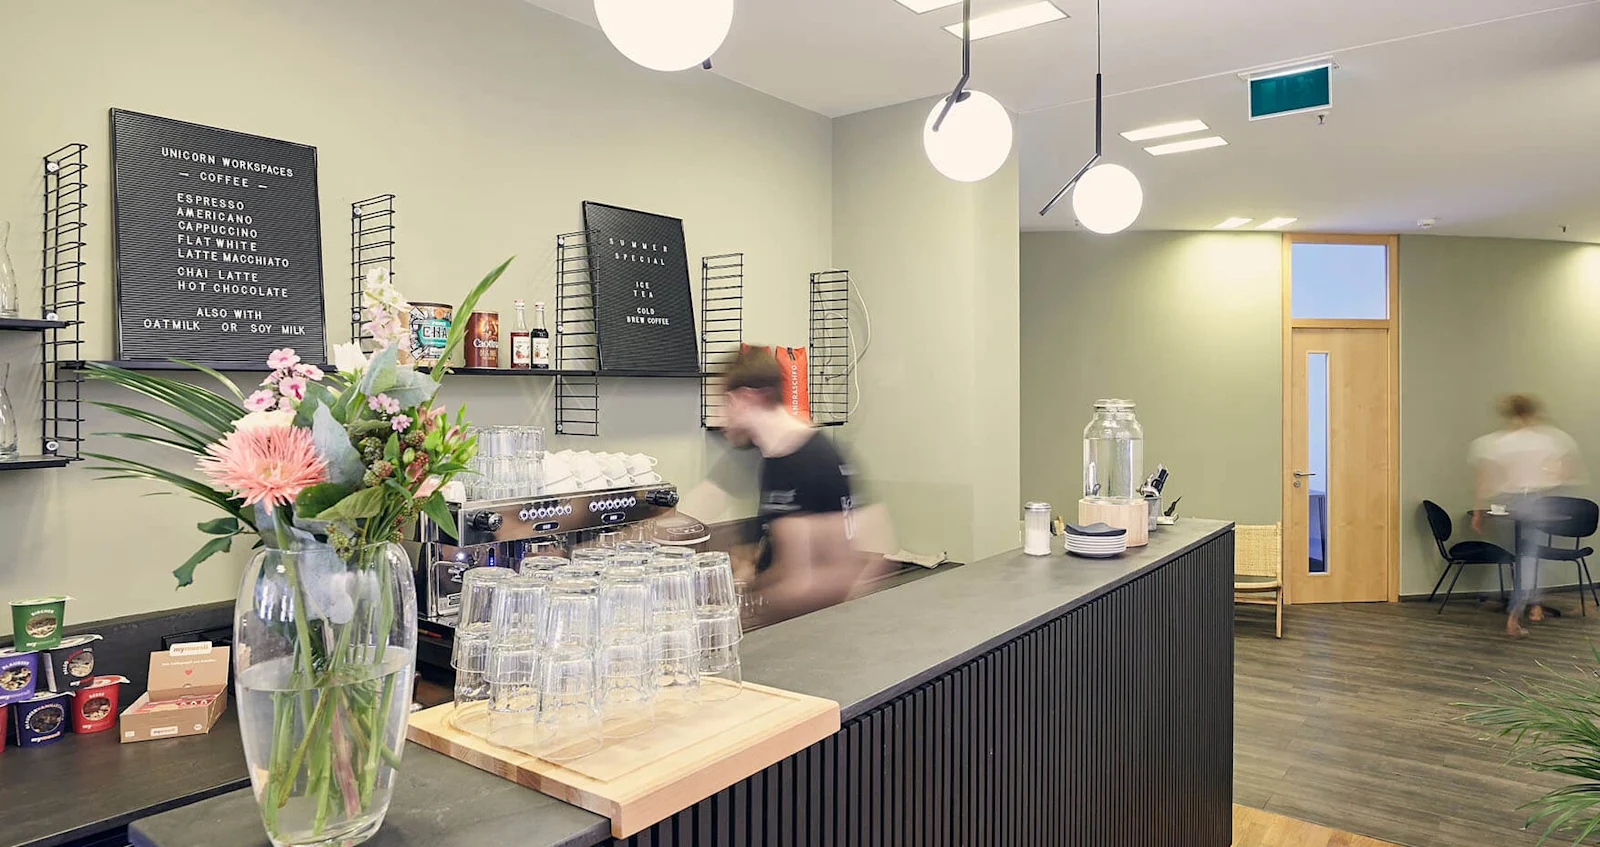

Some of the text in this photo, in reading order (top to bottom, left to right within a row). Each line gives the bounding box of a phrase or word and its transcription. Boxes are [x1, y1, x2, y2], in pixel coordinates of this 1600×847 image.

[161, 147, 294, 178] UNICORN WORKSPACES
[200, 171, 249, 188] COFFEE
[177, 193, 245, 210] ESPRESSO
[176, 207, 253, 225] AMERICANO
[178, 221, 258, 239] CAPPUCCINO
[178, 235, 257, 252] FLAT WHITE
[609, 237, 668, 253] SUMMER
[178, 248, 290, 268] LATTE MACCHIATO
[614, 252, 666, 266] SPECIAL
[177, 267, 259, 283] CHAI LATTE
[178, 281, 288, 298] HOT CHOCOLATE
[635, 281, 651, 290] ICE
[632, 289, 654, 299] TEA
[196, 308, 262, 321] ALSO WITH
[636, 307, 655, 316] COLD
[143, 318, 306, 336] OATMILK OR SOY MILK
[626, 316, 670, 326] BREW COFFEE
[422, 326, 448, 338] CHA
